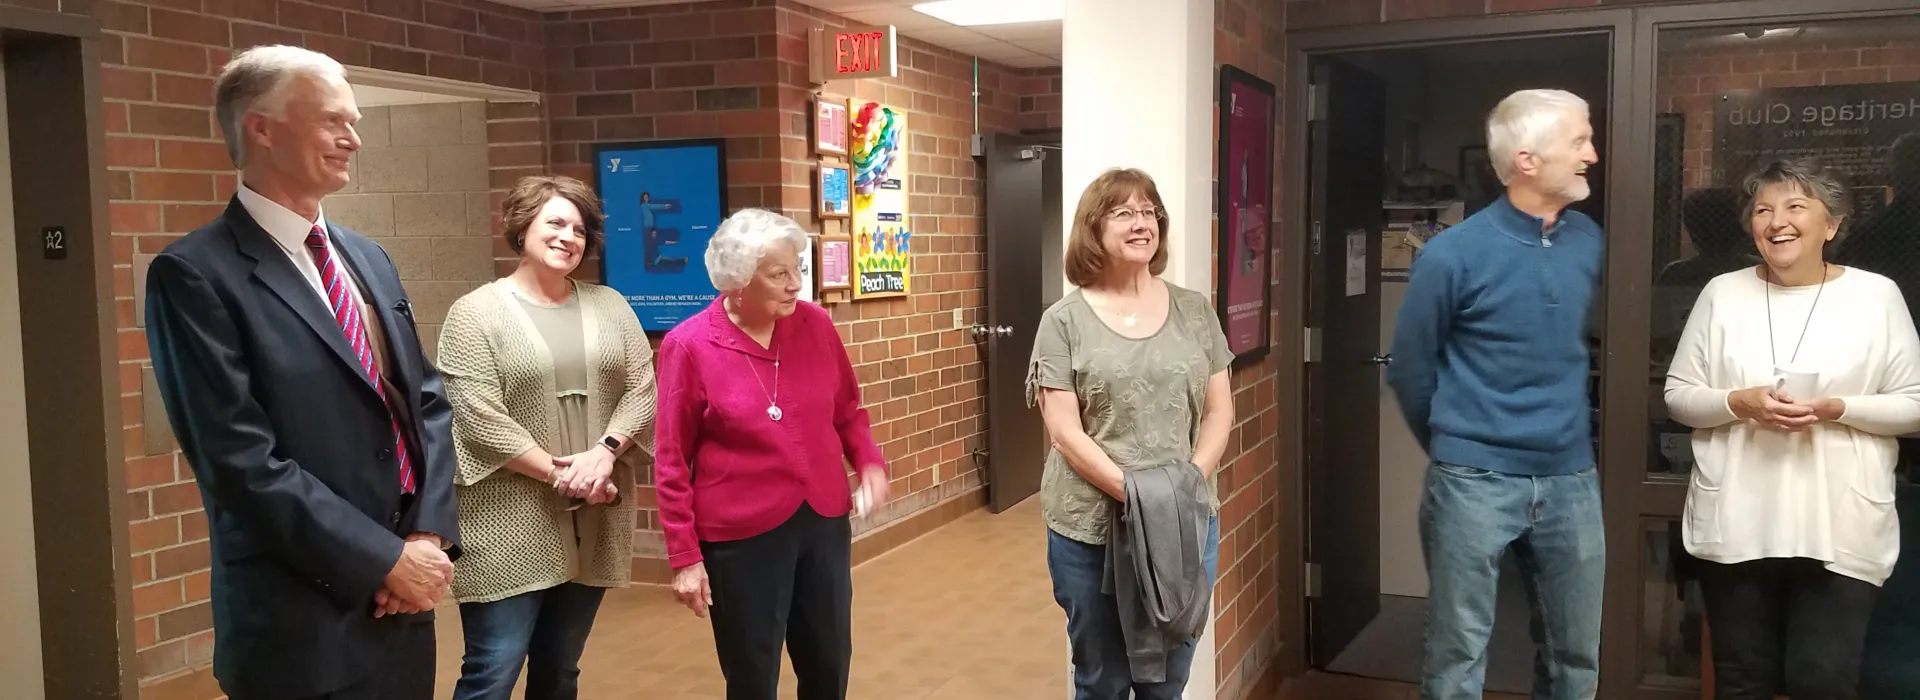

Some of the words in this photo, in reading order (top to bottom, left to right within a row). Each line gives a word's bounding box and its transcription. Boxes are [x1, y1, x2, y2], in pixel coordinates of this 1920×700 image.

[836, 32, 883, 73] EXIT
[55, 231, 63, 249] 2
[860, 274, 885, 292] Peach
[886, 274, 904, 290] Tree
